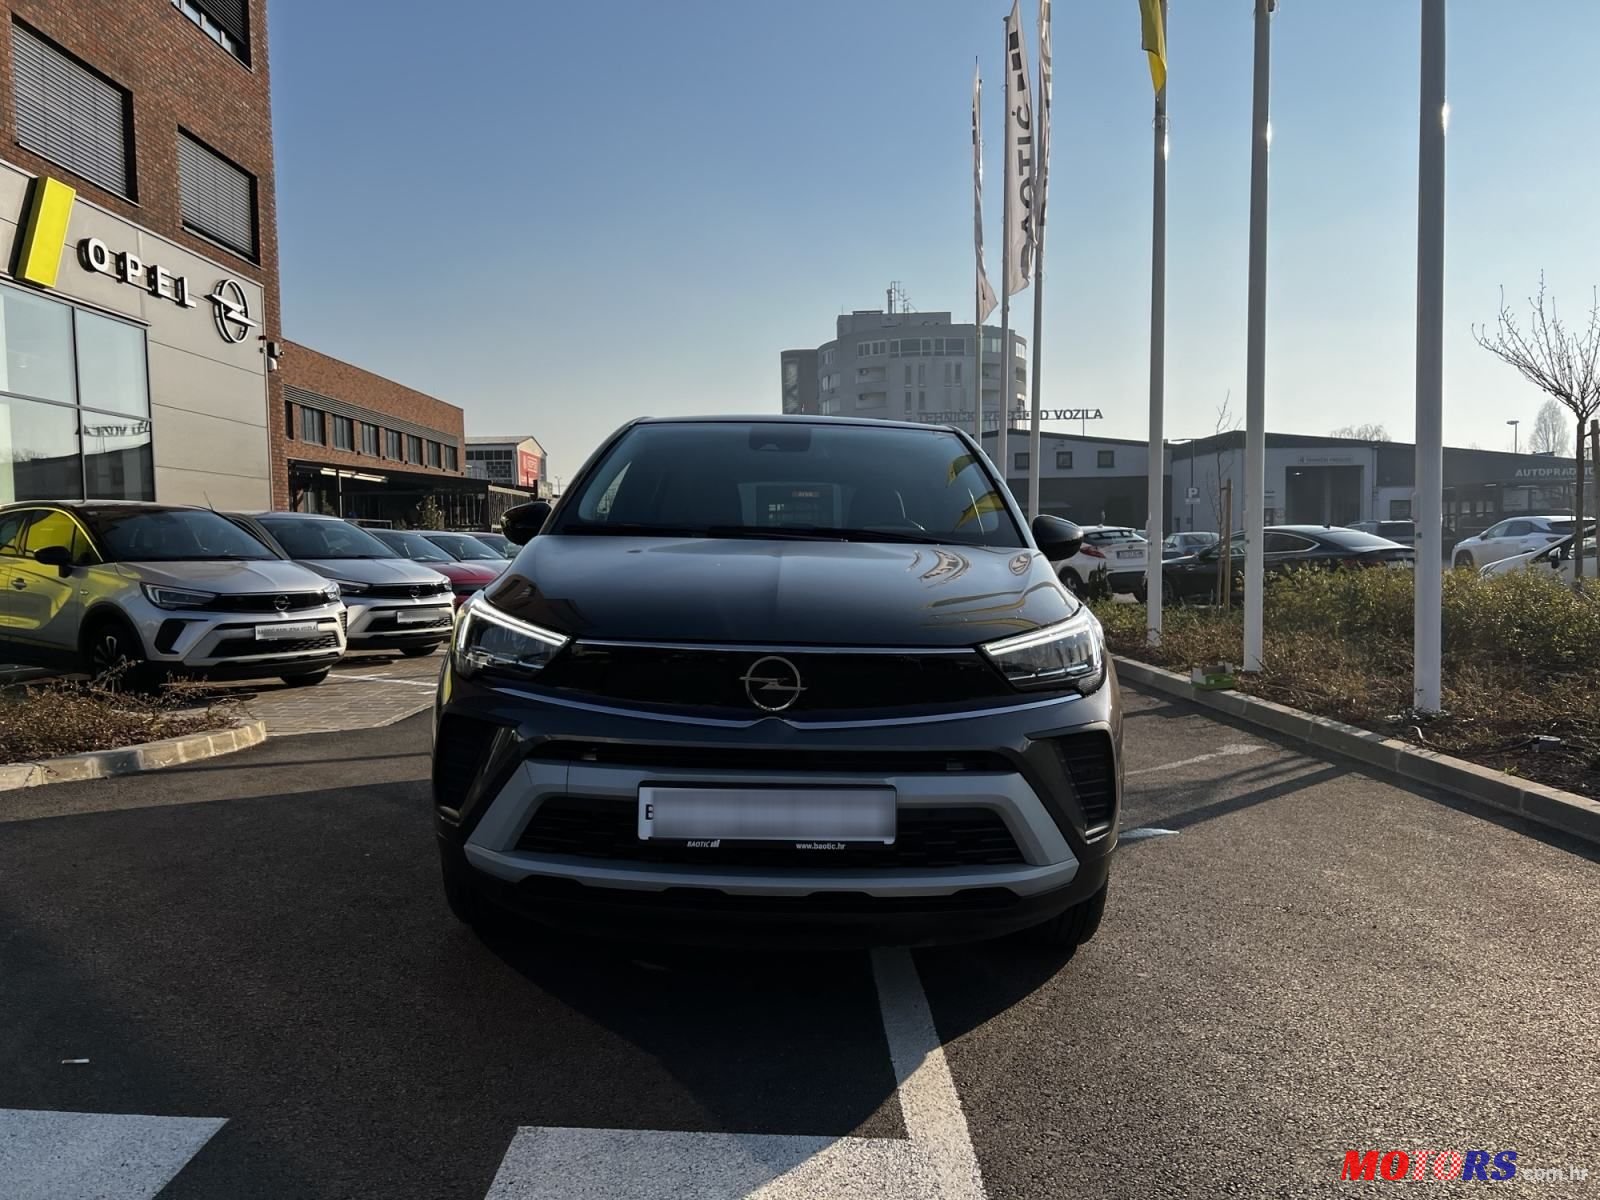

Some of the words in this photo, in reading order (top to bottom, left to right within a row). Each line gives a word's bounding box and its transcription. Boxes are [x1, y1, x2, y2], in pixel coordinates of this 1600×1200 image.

[79, 237, 197, 309] OPEL
[918, 409, 975, 422] TEHNIČK
[1054, 409, 1103, 420] VOZILA
[1188, 488, 1198, 498] P
[796, 842, 845, 850] www.baotic.hr
